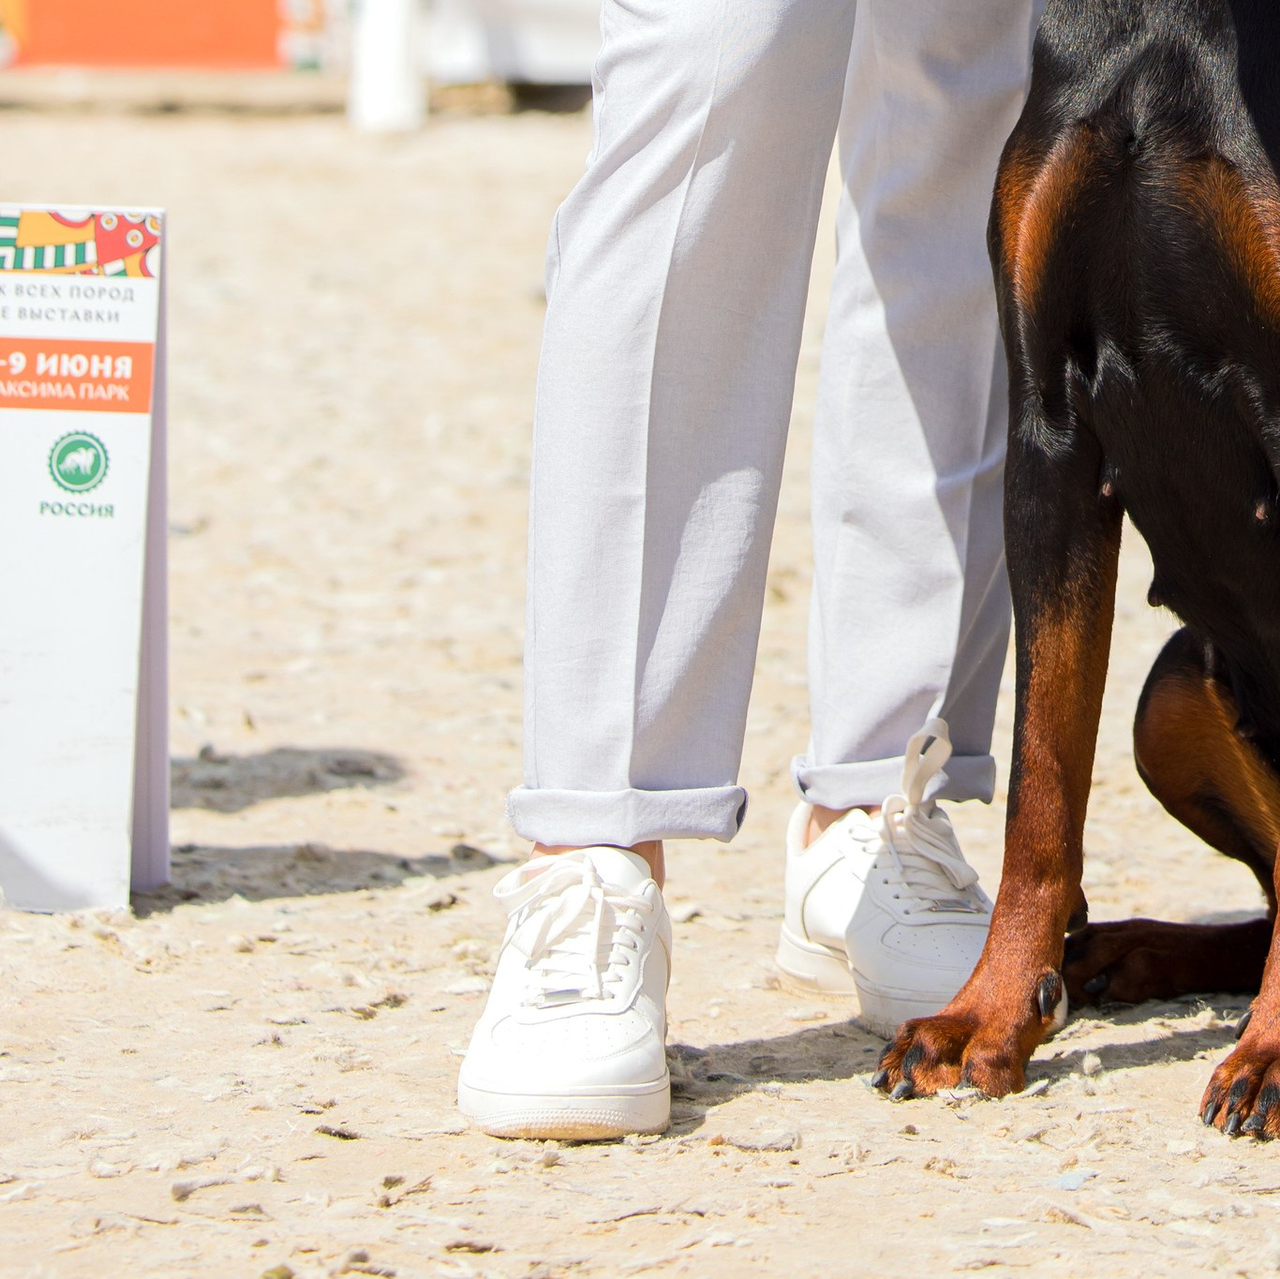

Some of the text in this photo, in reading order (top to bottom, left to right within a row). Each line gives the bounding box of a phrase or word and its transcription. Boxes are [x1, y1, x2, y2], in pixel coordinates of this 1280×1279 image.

[14, 283, 62, 298] ВСЕХ
[69, 285, 135, 302] ПОРОД
[18, 307, 120, 323] ВЫСТАВКИ
[36, 352, 133, 379] ИЮНЯ
[0, 380, 129, 401] АКСИМА ПАРК
[39, 501, 115, 518] РОССИЯ
